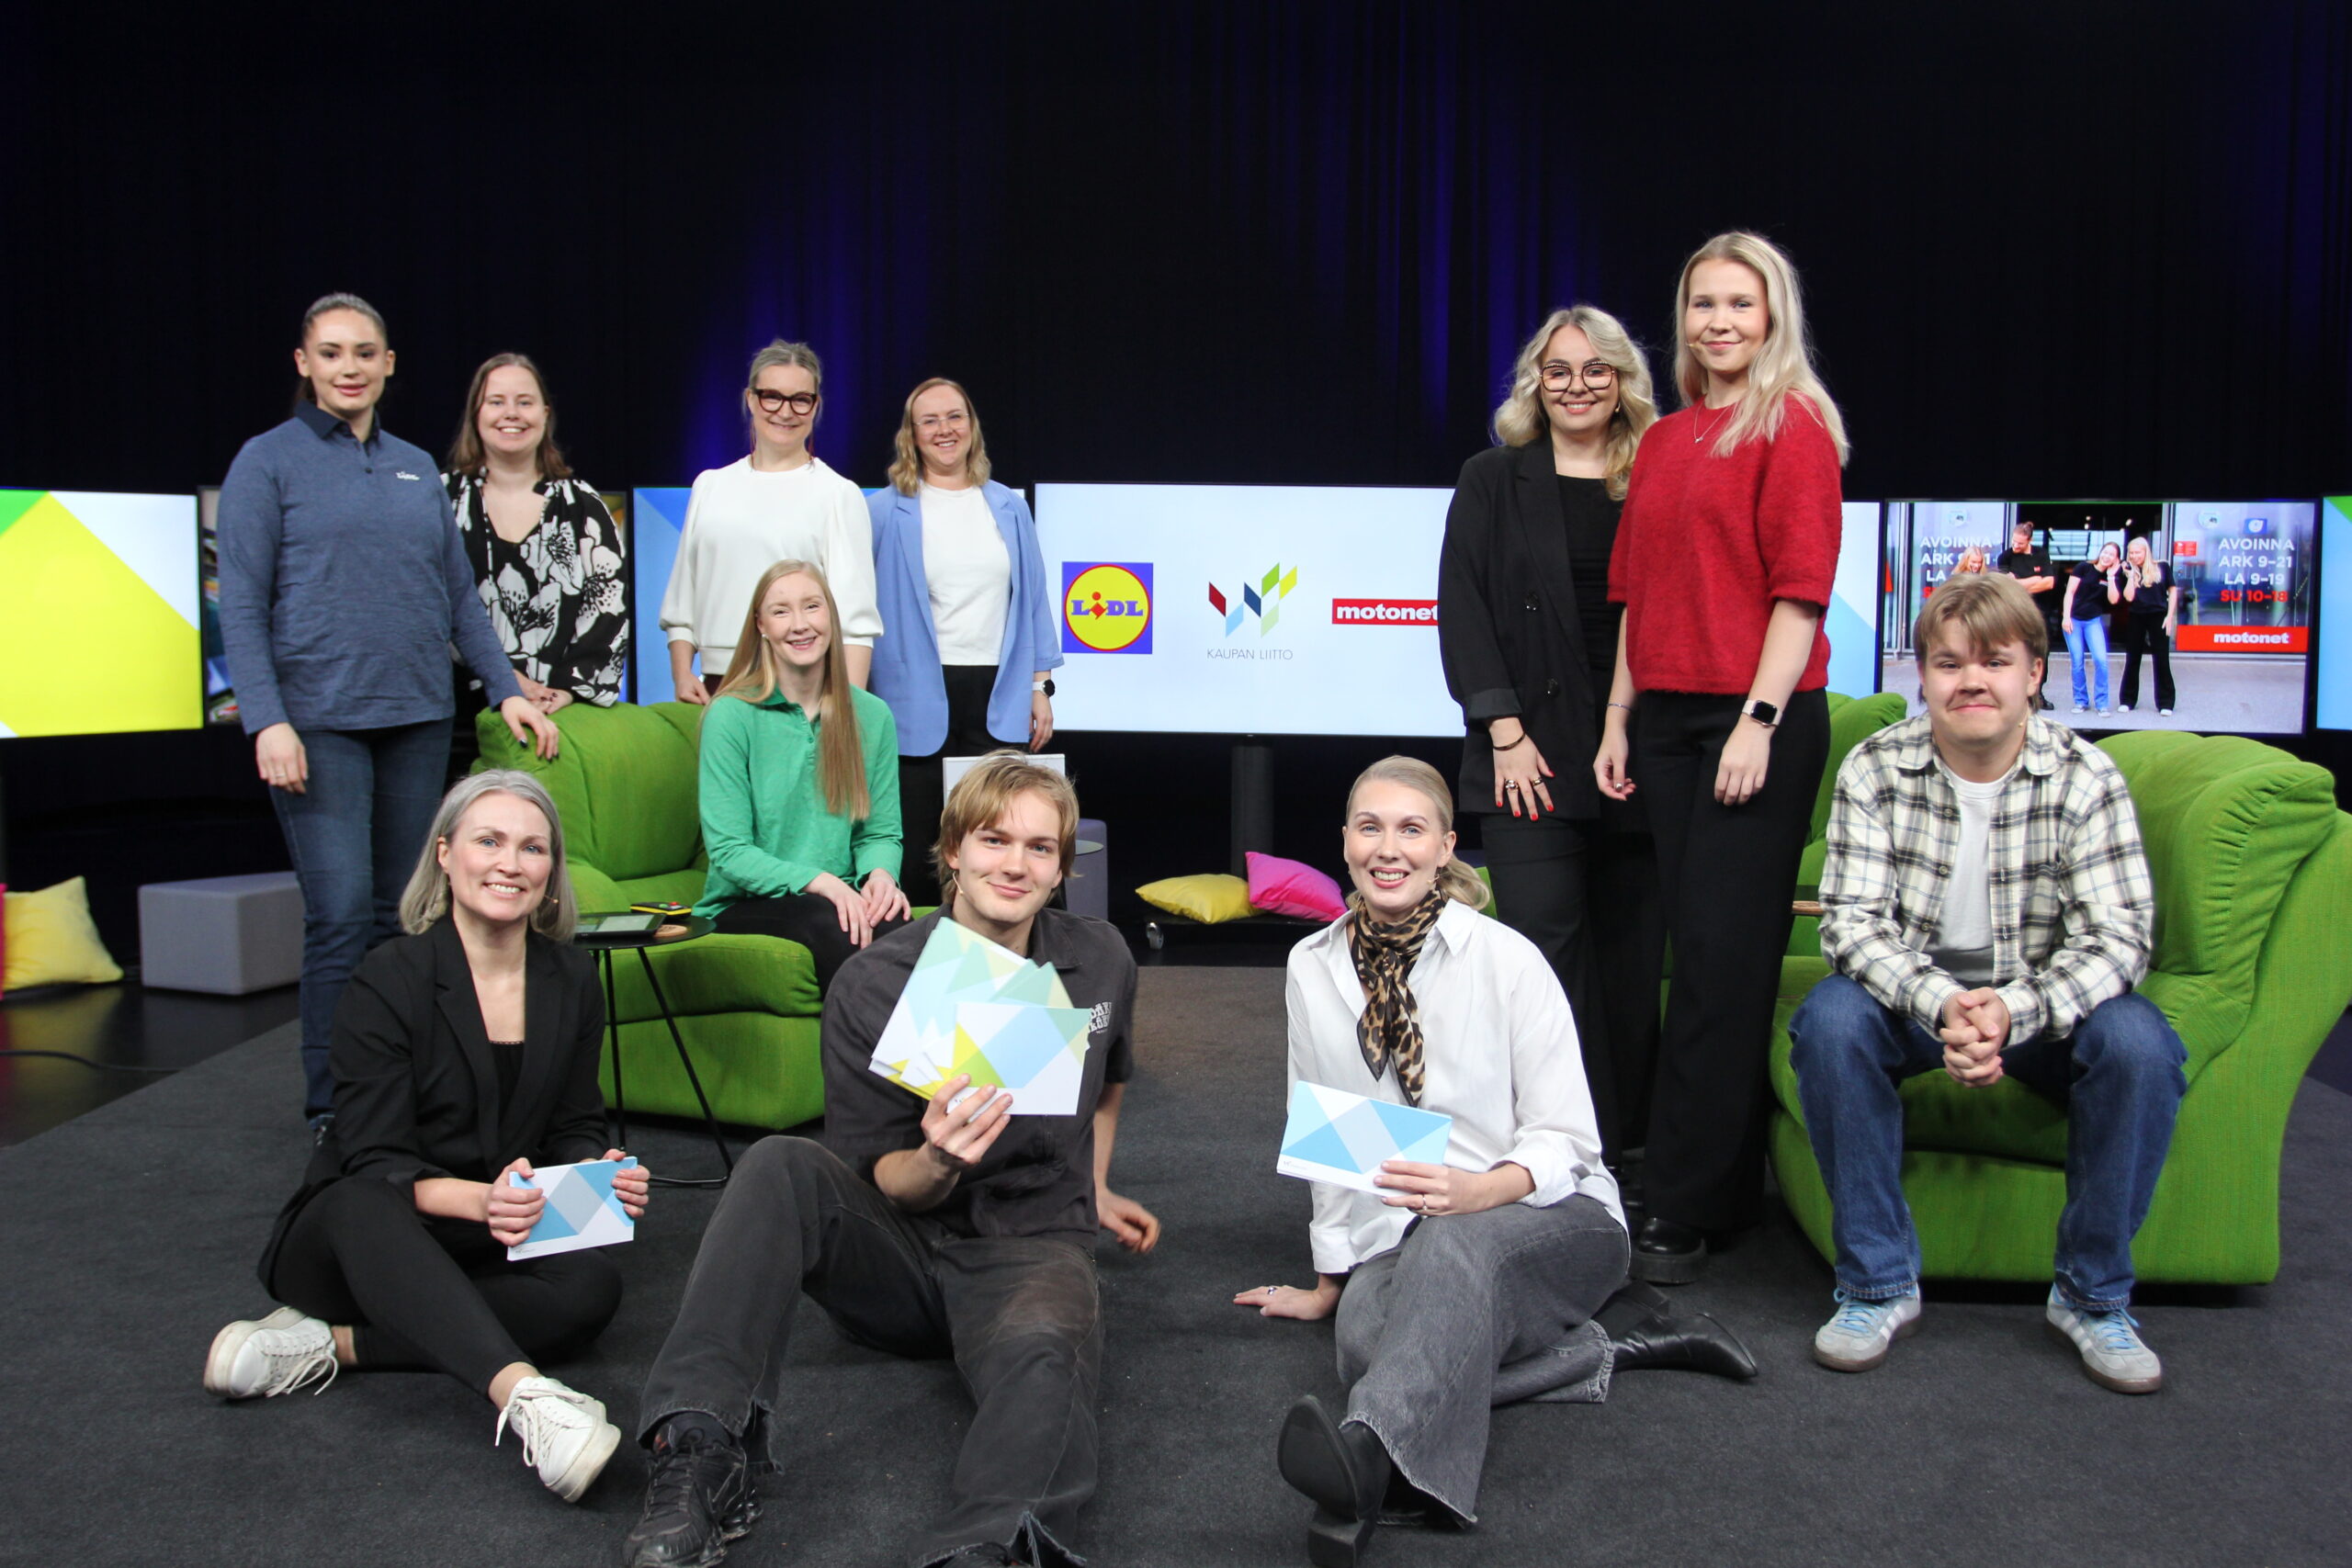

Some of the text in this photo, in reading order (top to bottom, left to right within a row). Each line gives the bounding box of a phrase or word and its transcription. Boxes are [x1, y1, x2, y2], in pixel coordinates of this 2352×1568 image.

[1919, 536, 1993, 548] AVOINNA
[2219, 538, 2294, 551] AVOINNA
[1920, 553, 1954, 565] ARK
[2219, 556, 2292, 568] ARK 9-21
[1926, 570, 1947, 581] LA
[2223, 573, 2285, 585] LA 9-19
[2220, 590, 2289, 603] SU 10-18
[2213, 632, 2290, 644] motonet
[1206, 648, 1294, 660] KAUPAN LIITTO
